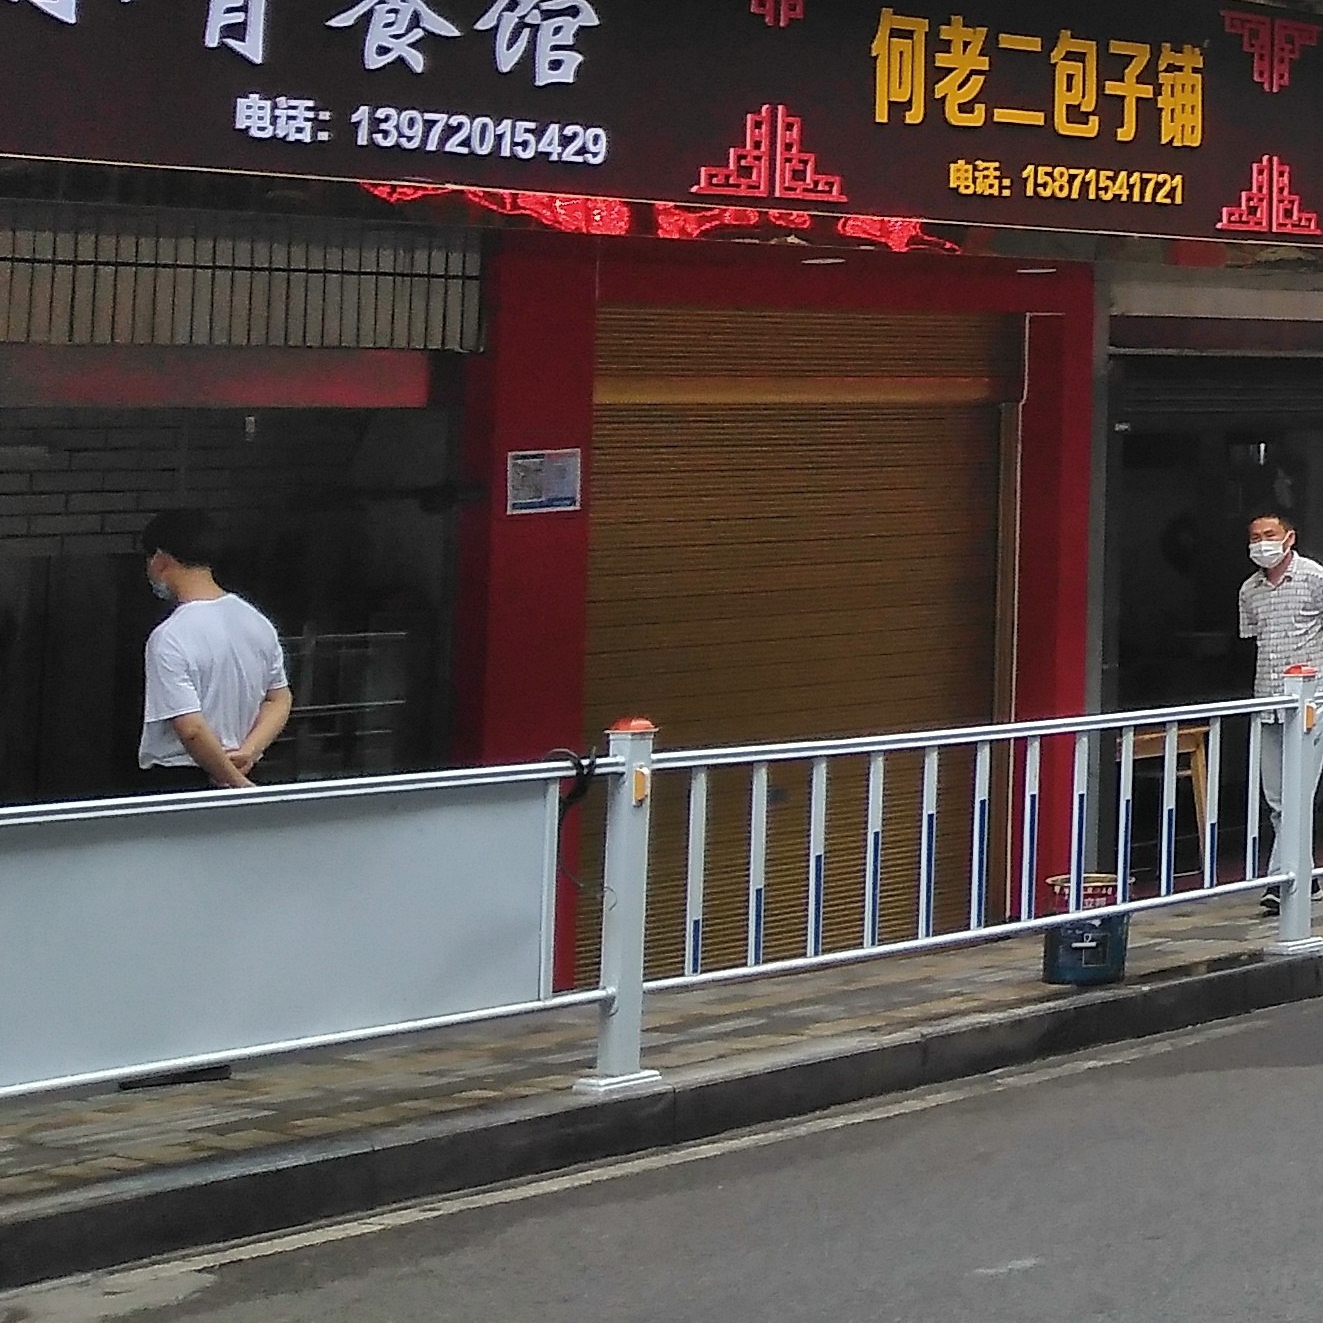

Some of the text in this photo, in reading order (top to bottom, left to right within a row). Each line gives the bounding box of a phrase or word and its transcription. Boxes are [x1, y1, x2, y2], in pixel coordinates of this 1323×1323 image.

[870, 7, 1204, 148] 何老二包子铺
